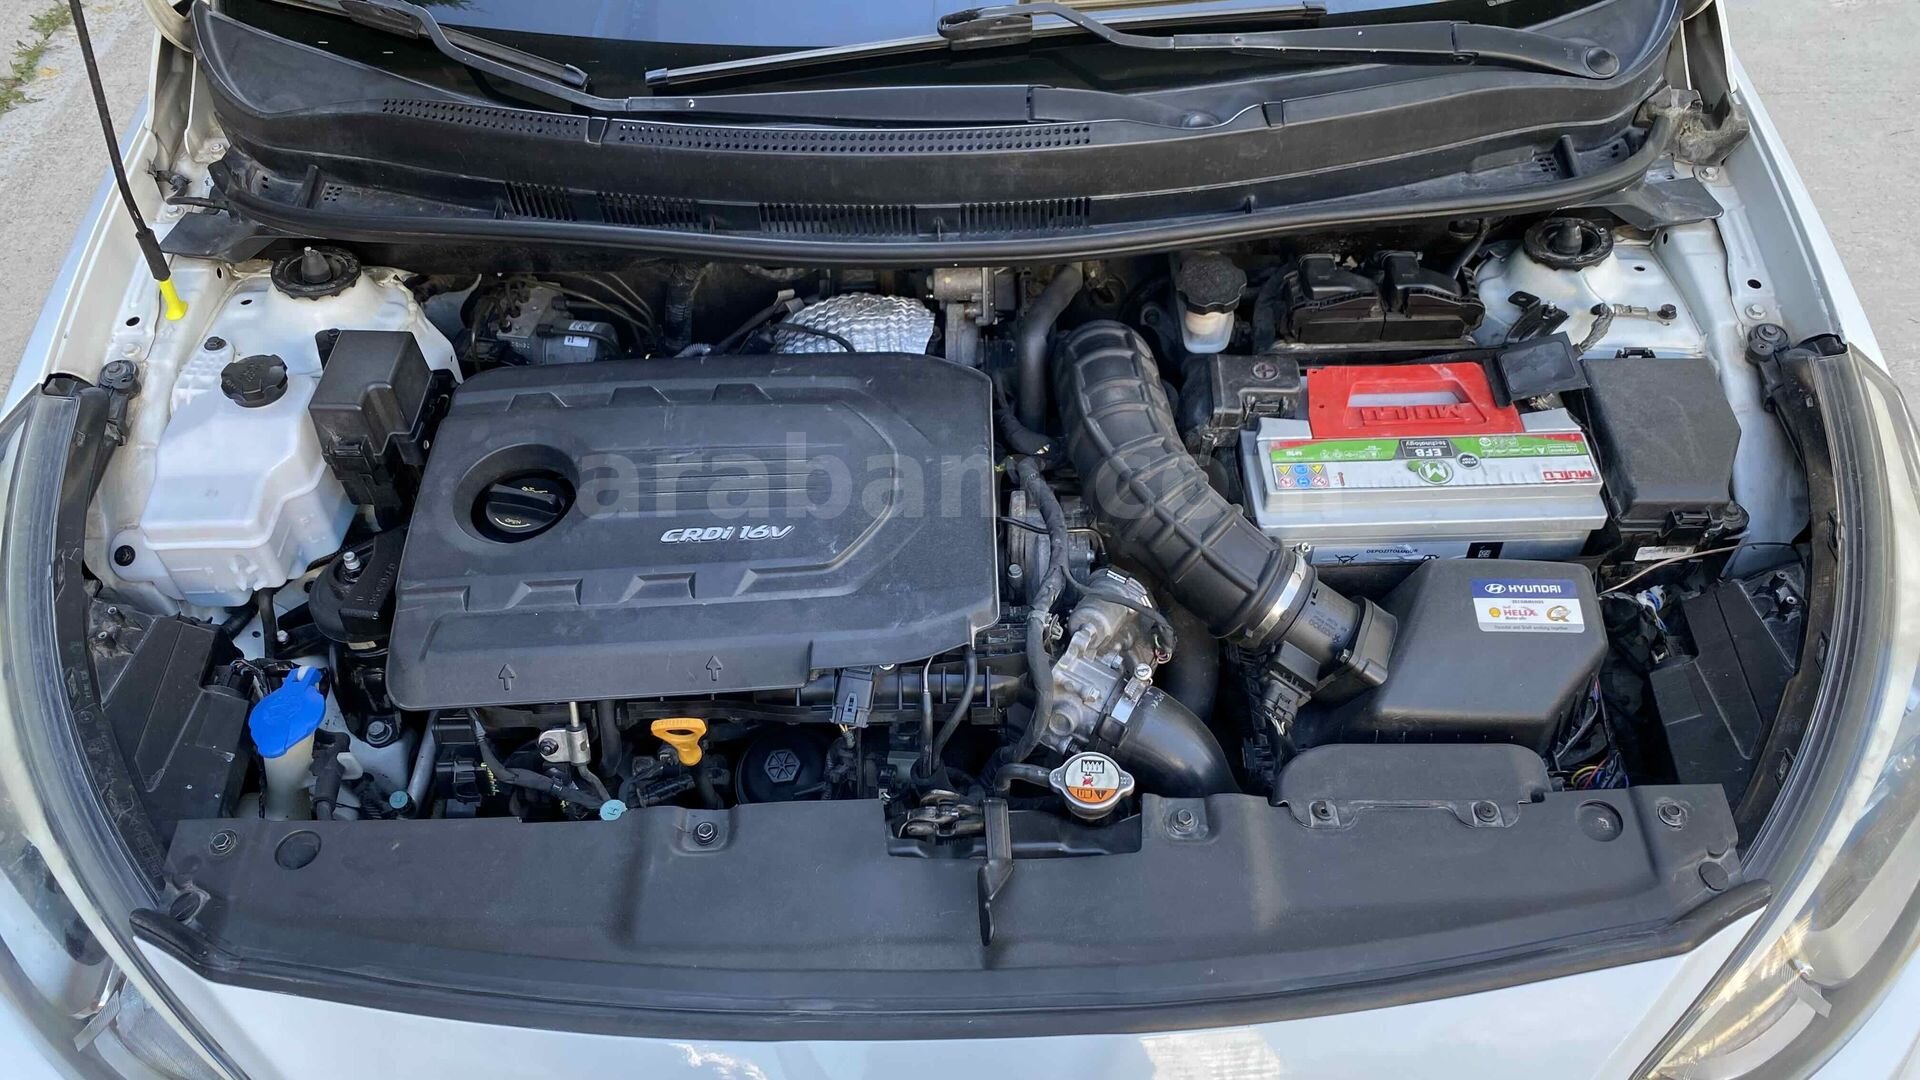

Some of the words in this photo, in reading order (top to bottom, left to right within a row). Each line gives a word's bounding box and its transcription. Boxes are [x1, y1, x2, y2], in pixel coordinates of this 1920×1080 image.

[1415, 448, 1442, 457] EFB
[505, 517, 521, 525] OPEN
[739, 524, 795, 541] 16V
[1508, 584, 1561, 593] HYUNDAI
[1503, 608, 1536, 616] HELIX
